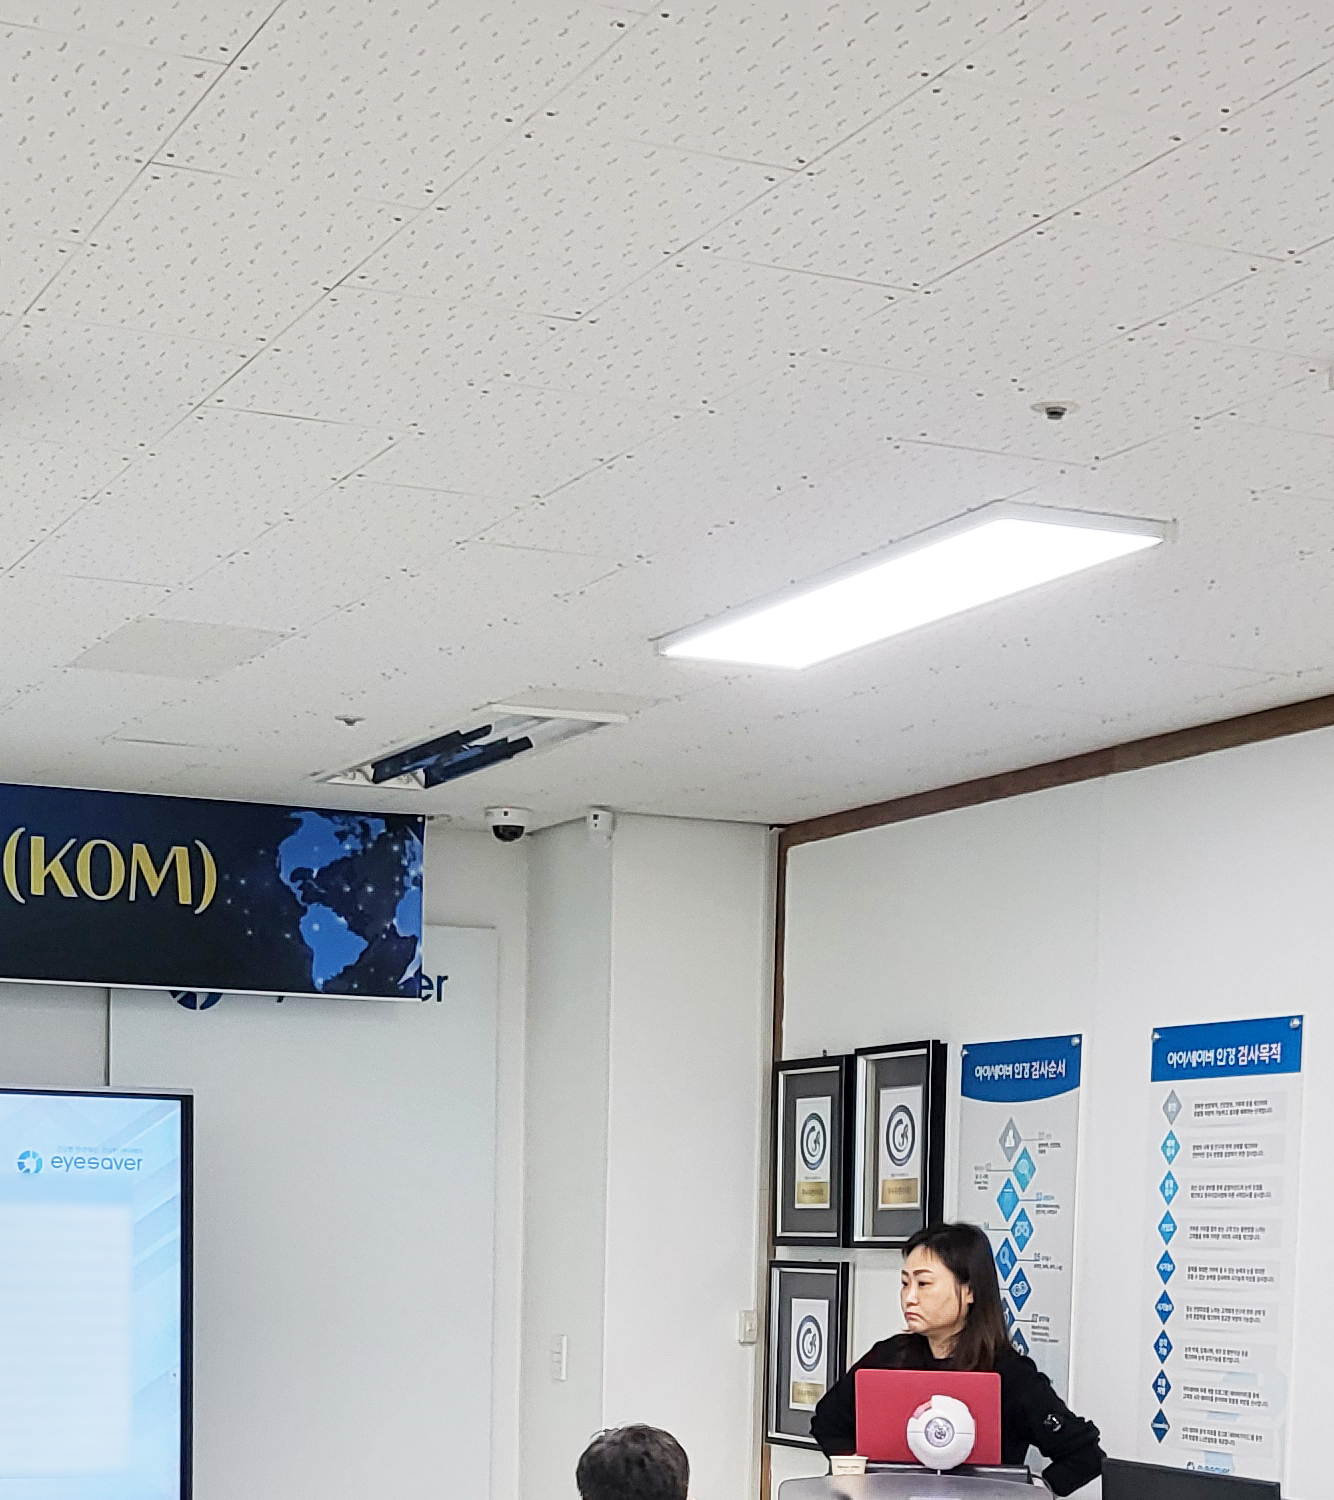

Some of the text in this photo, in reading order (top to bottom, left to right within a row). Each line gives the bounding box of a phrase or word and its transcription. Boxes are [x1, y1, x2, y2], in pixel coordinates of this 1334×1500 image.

[3, 826, 217, 915] (KOM)
[1167, 1049, 1214, 1068] 아이세이버
[1237, 1042, 1282, 1066] 검사목적
[974, 1063, 1013, 1082] 아이세이버
[1031, 1058, 1066, 1080] 검사순서
[51, 1155, 144, 1172] eyesaver
